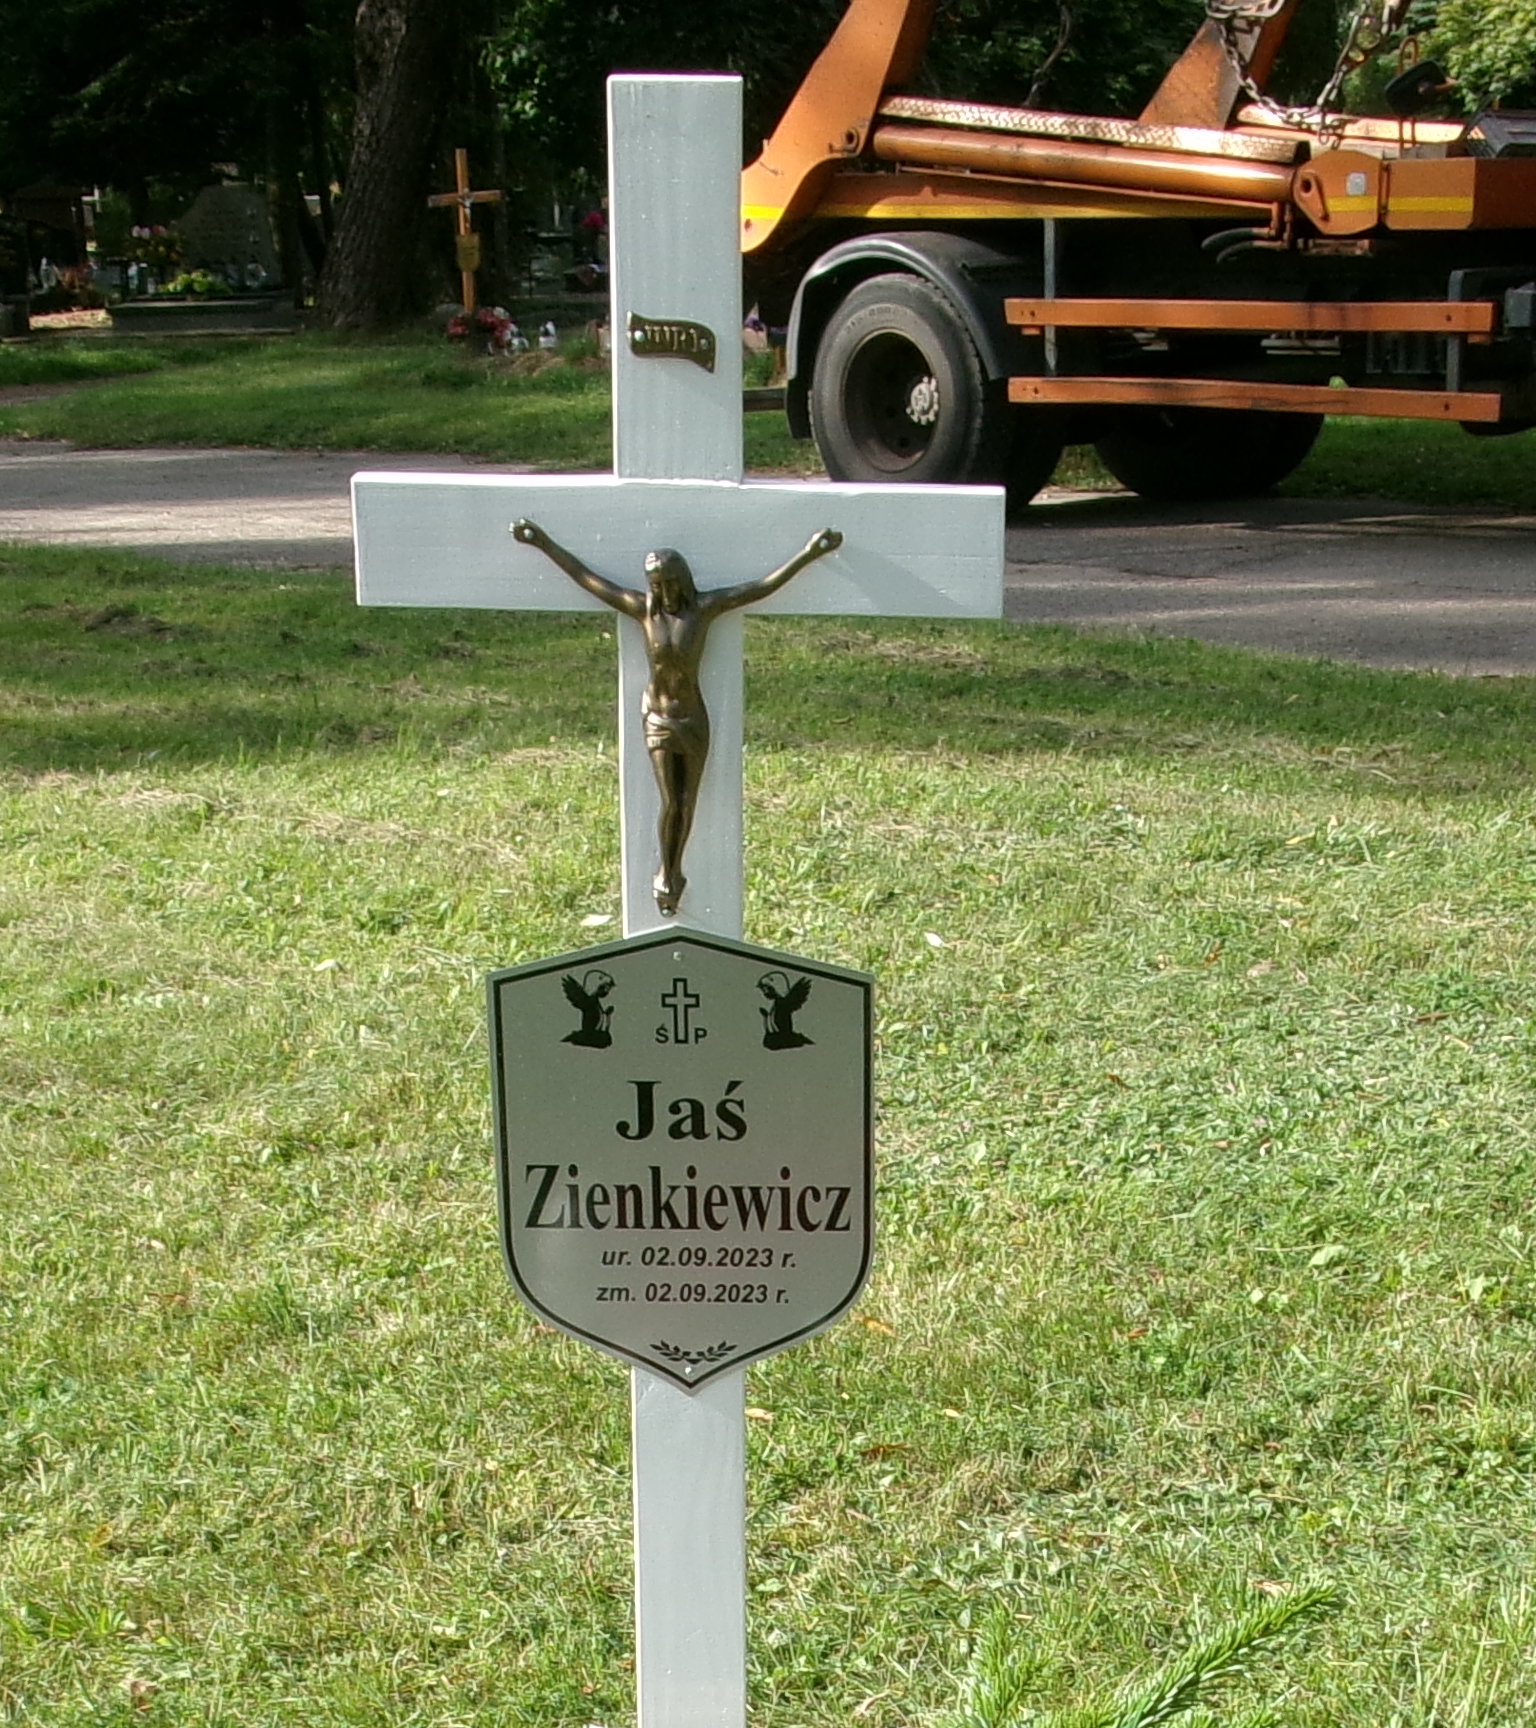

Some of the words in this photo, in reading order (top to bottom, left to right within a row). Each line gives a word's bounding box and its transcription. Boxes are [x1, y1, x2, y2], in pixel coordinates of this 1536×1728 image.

[655, 1023, 670, 1044] Ś
[694, 1027, 708, 1045] P
[615, 1080, 748, 1142] Jaś
[524, 1163, 852, 1233] Zienkiewicz
[601, 1250, 632, 1266] ur.
[641, 1246, 774, 1268] 02.09.2023
[781, 1253, 796, 1268] r.
[596, 1287, 636, 1302] zm.
[645, 1282, 768, 1304] 02.09.2023
[776, 1289, 789, 1304] r.
